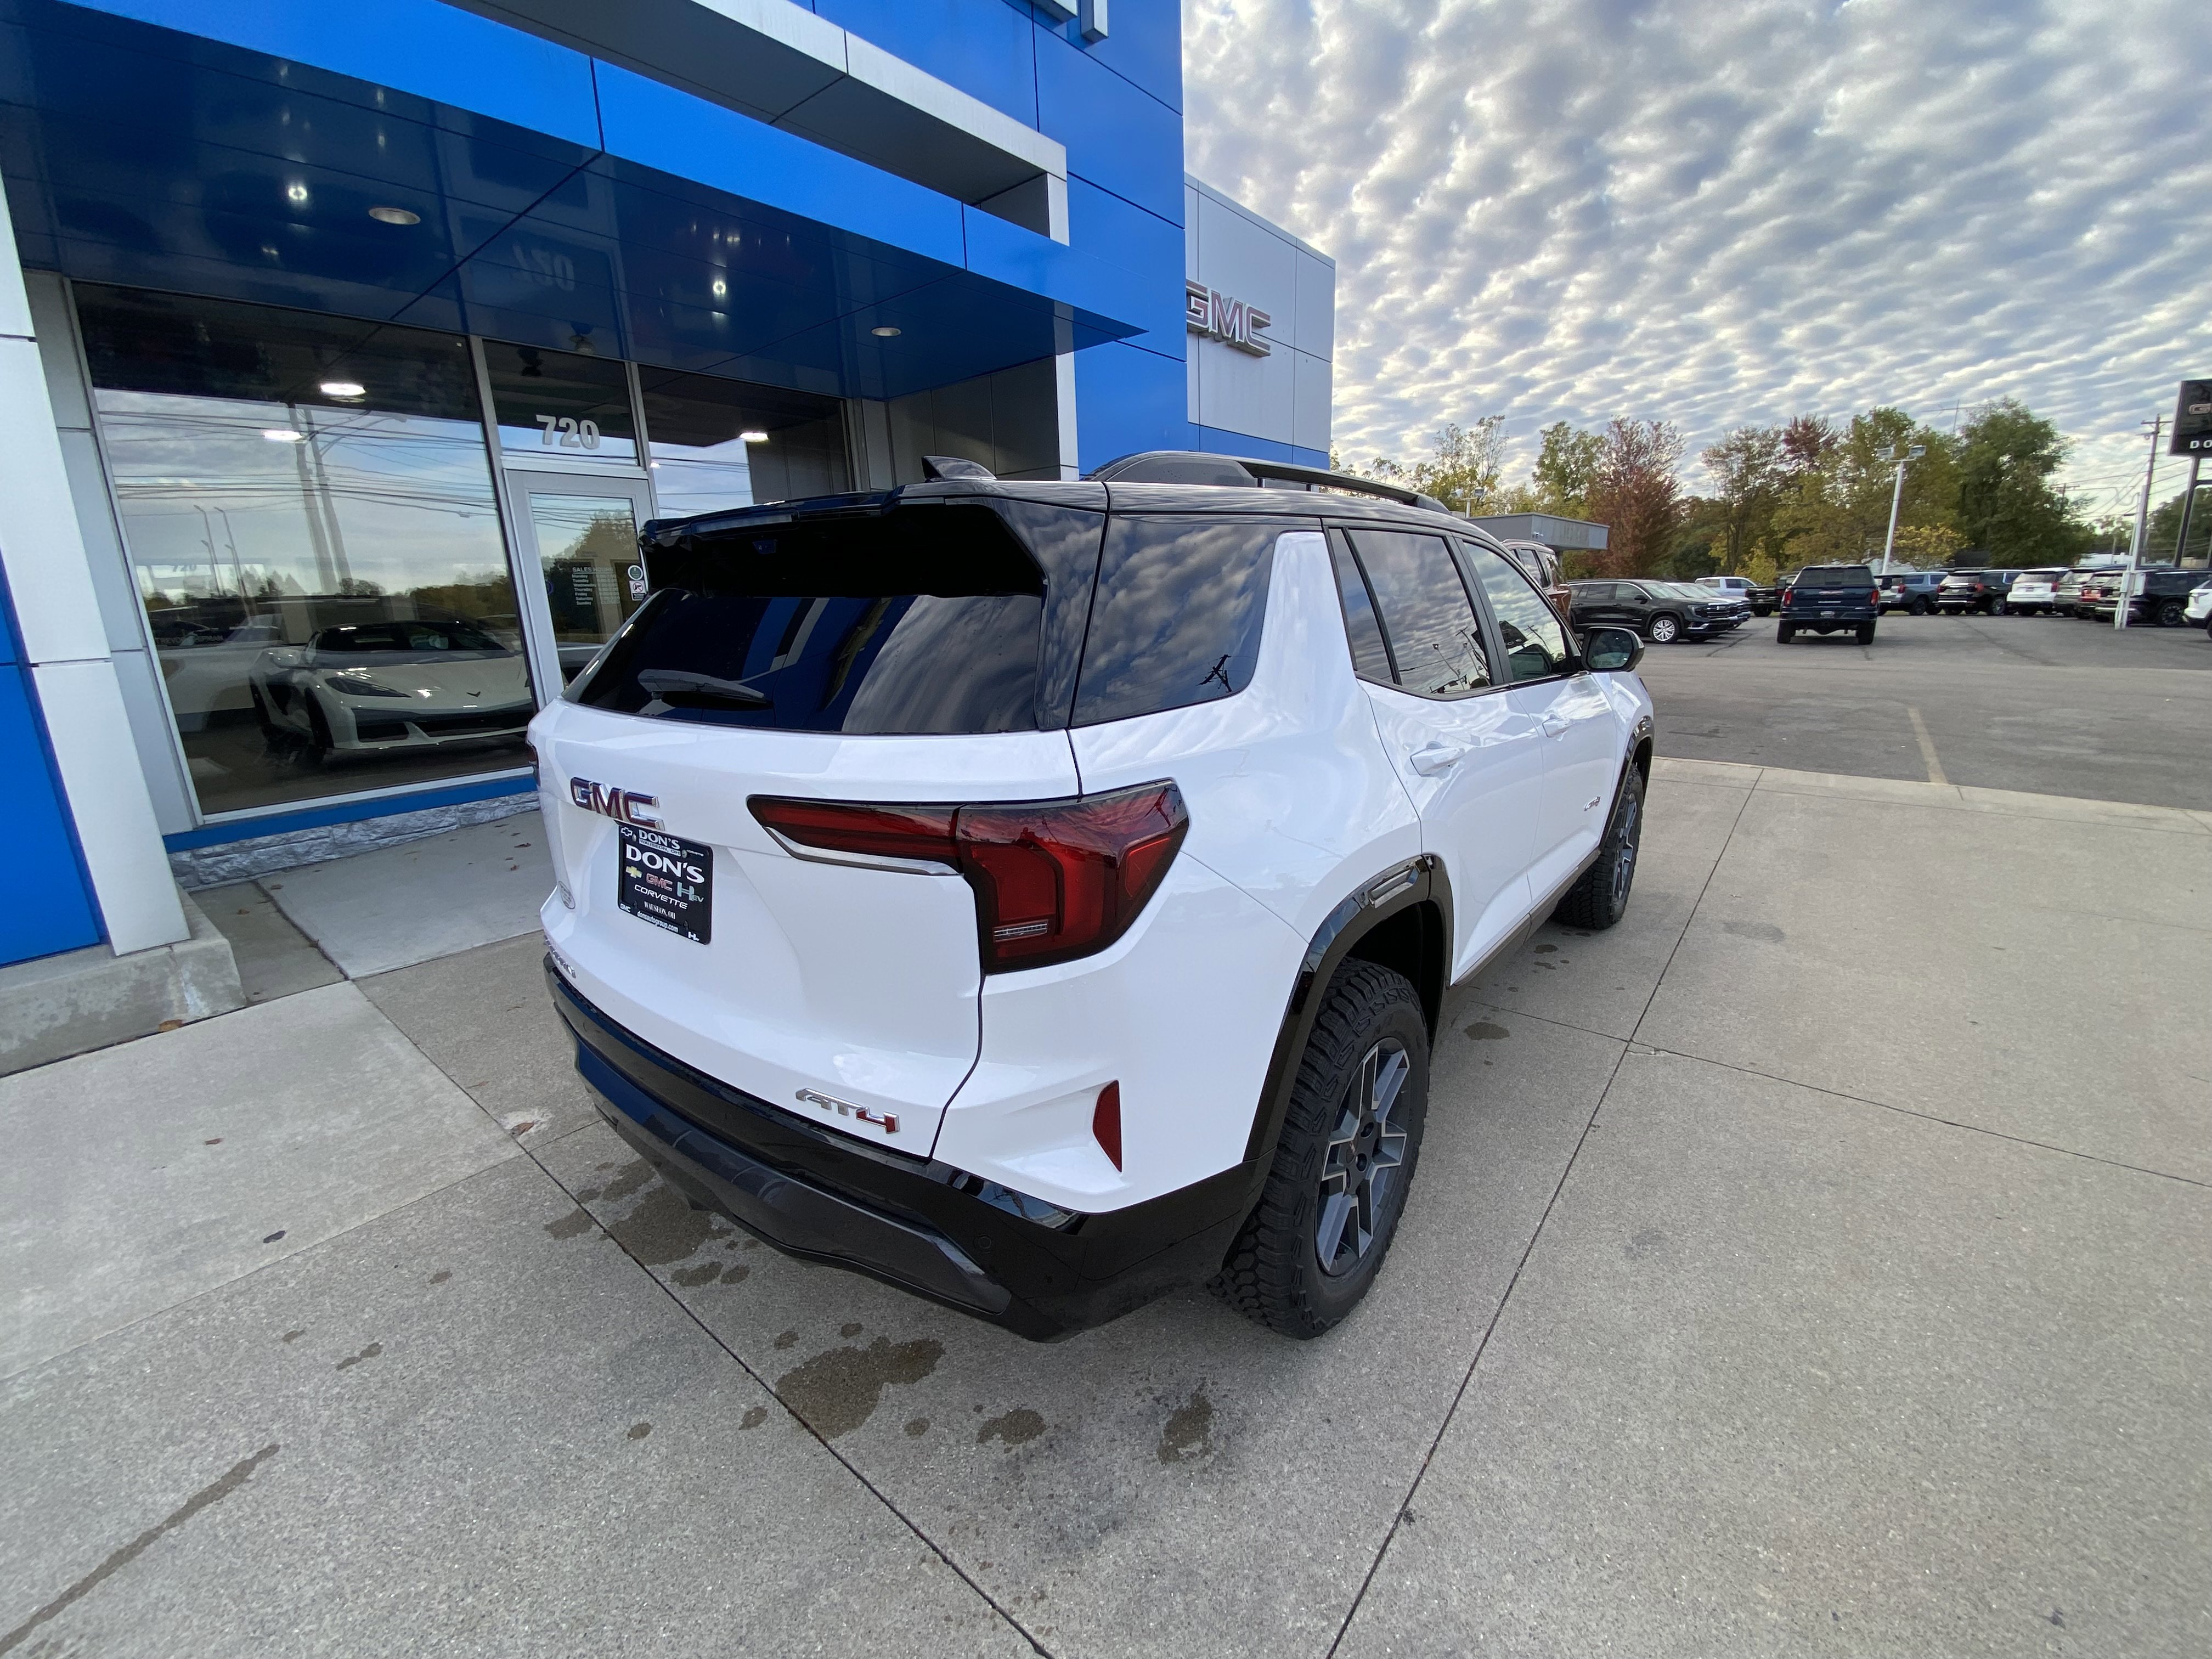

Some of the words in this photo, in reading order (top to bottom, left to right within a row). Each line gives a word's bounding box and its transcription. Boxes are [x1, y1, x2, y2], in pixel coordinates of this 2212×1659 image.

[1186, 278, 1271, 357] GMC
[535, 414, 600, 450] 720
[571, 776, 665, 831] GMC
[639, 829, 680, 850] DON'S
[626, 844, 705, 883] DON'S
[646, 873, 673, 891] GMC
[634, 884, 689, 910] CORVETTE
[795, 1088, 900, 1134] AT4
